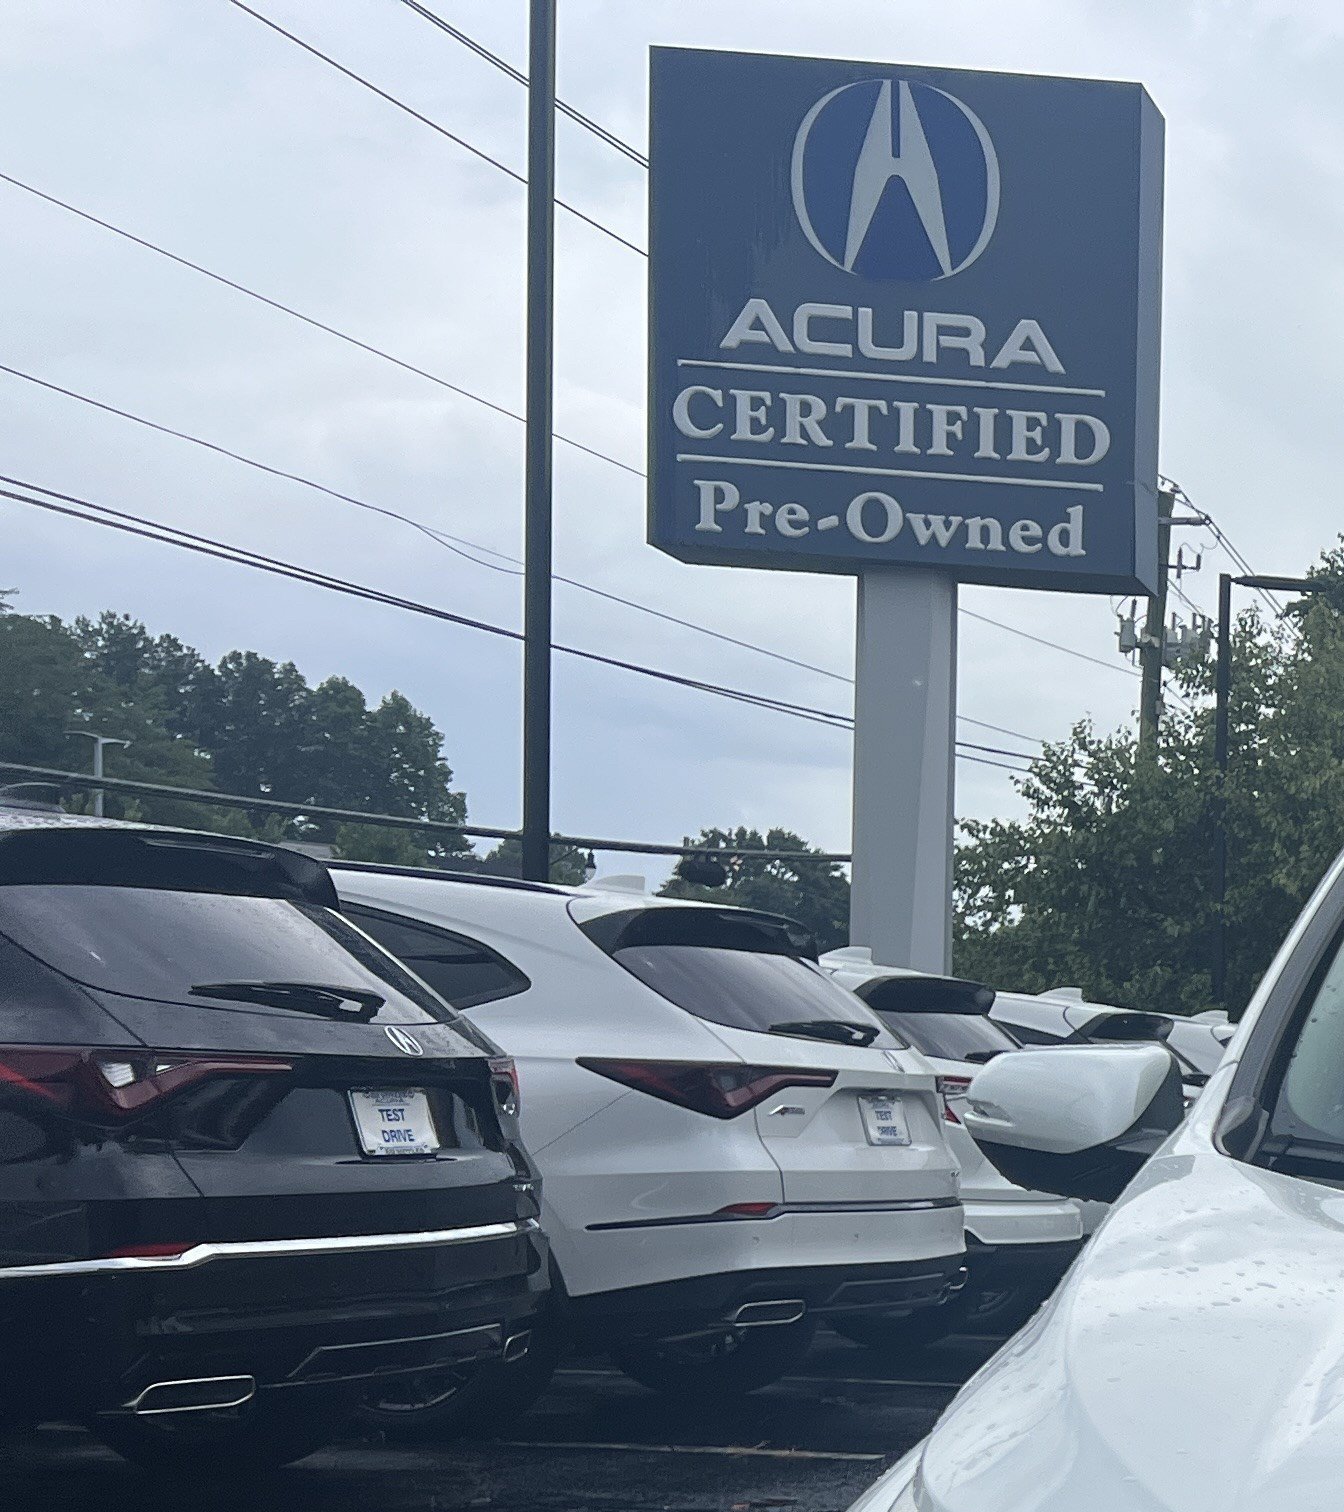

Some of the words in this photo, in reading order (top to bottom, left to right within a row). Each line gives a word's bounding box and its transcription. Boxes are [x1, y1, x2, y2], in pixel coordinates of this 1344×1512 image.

[719, 298, 1066, 375] ACURA
[672, 385, 1111, 467] CERTIFIED
[693, 479, 1087, 557] Pre-Owned
[378, 1108, 405, 1122] TEST
[381, 1128, 415, 1143] DRIVE
